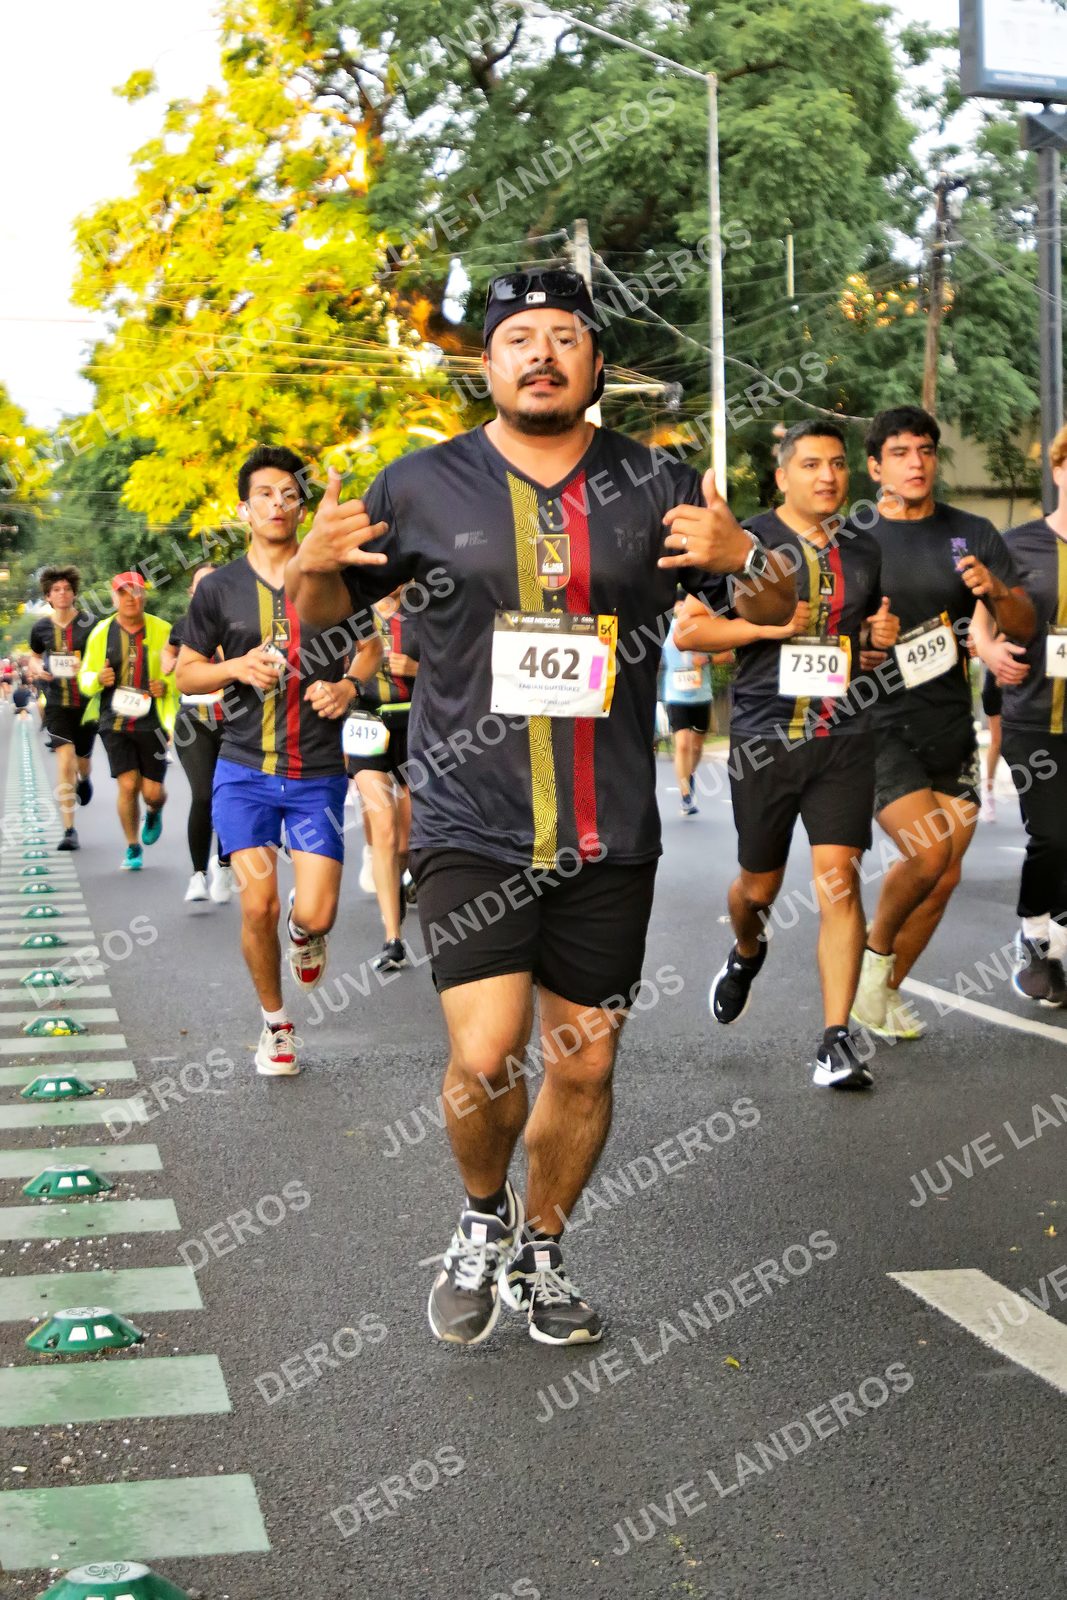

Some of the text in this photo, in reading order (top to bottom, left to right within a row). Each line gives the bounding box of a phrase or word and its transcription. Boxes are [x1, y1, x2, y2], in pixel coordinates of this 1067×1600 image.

[907, 634, 946, 665] 4959
[518, 646, 580, 680] 462
[791, 653, 839, 673] 7350
[348, 723, 379, 741] 3419
